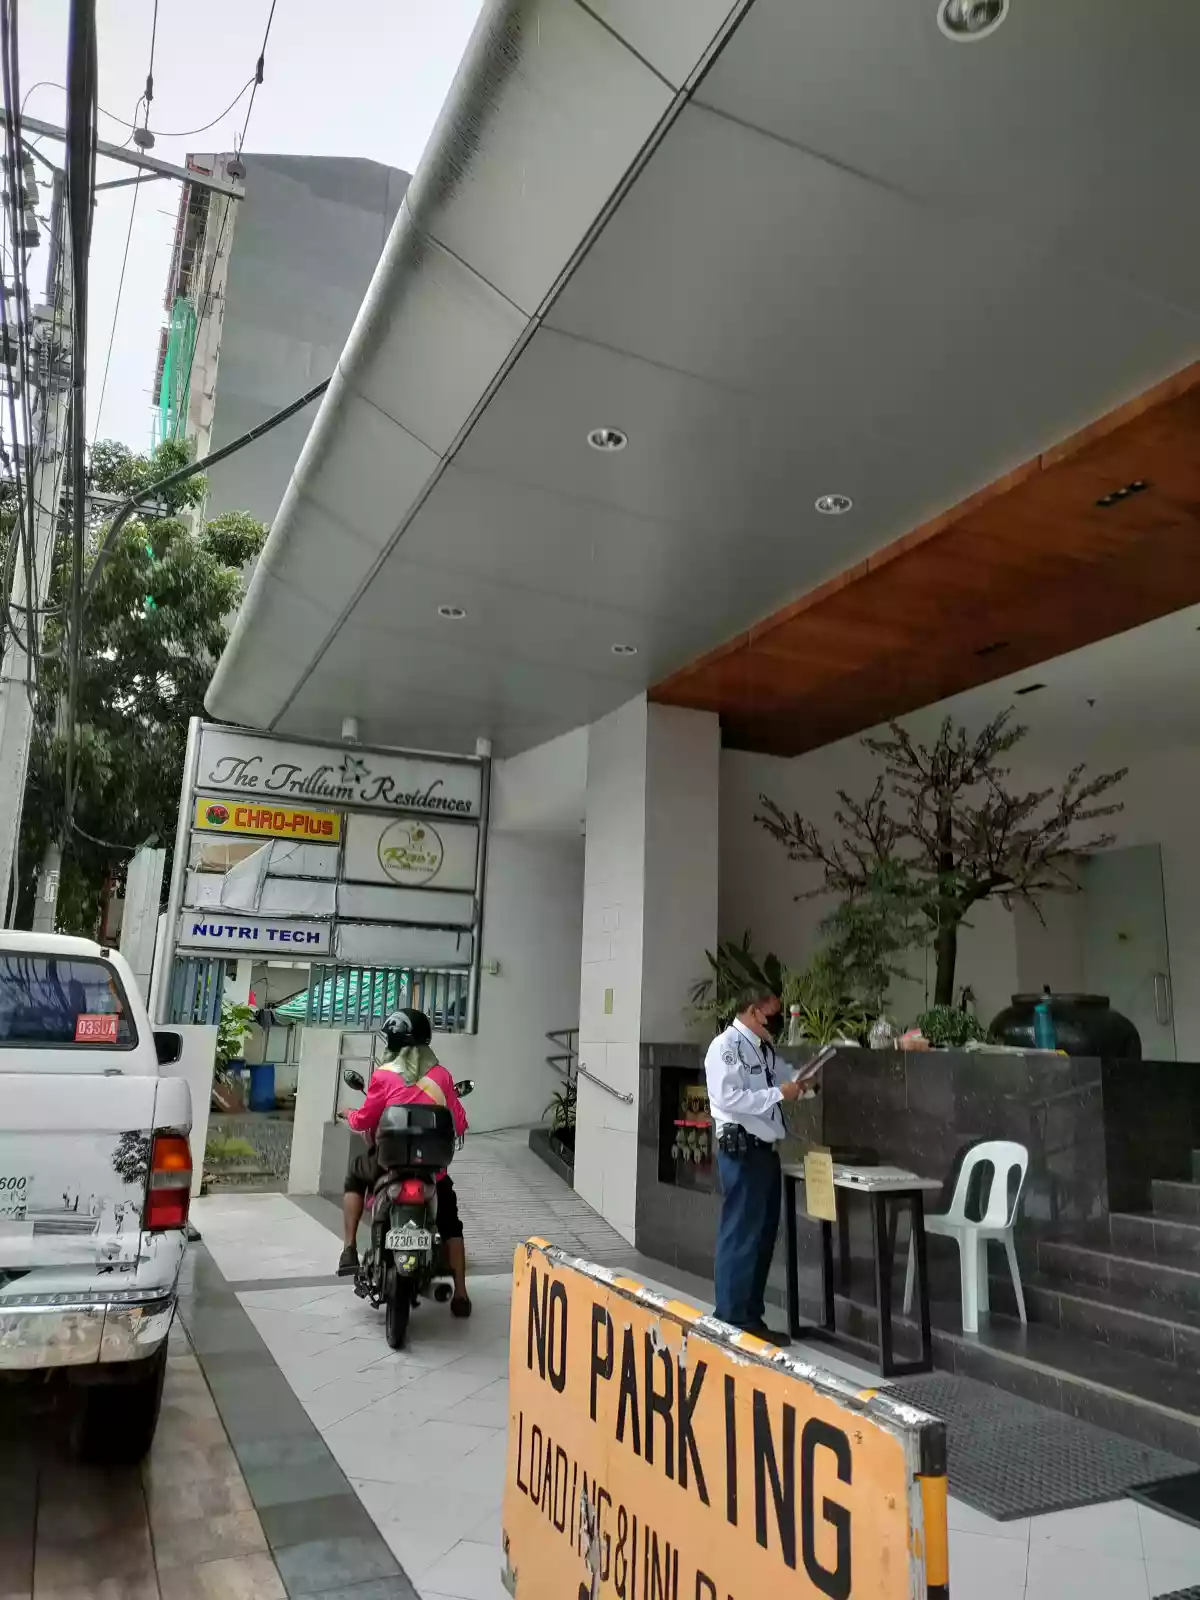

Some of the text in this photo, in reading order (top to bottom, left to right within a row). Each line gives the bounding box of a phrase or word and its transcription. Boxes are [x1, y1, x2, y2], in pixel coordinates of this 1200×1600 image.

[209, 756, 472, 813] The Trillium Residences
[193, 923, 321, 944] NUTRI TECH
[527, 1265, 853, 1600] NO PARKING
